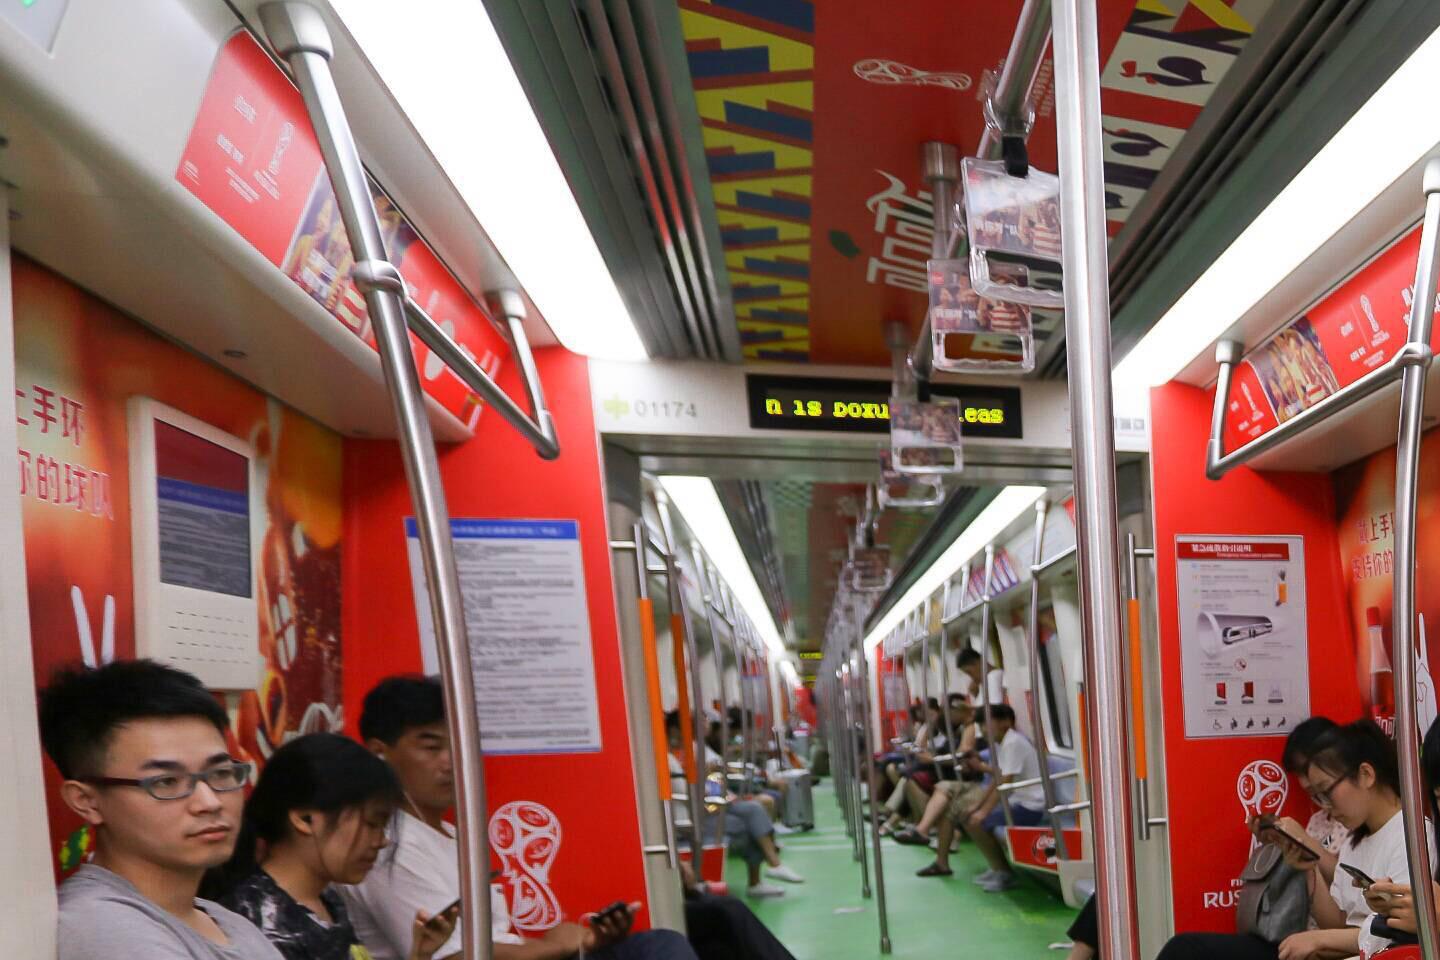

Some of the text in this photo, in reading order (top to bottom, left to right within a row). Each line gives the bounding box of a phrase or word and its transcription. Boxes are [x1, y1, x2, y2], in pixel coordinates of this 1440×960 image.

[16, 384, 84, 446] 手环
[634, 400, 697, 418] 01174
[1352, 549, 1395, 582] 支持你的
[1203, 890, 1242, 909] RUS
